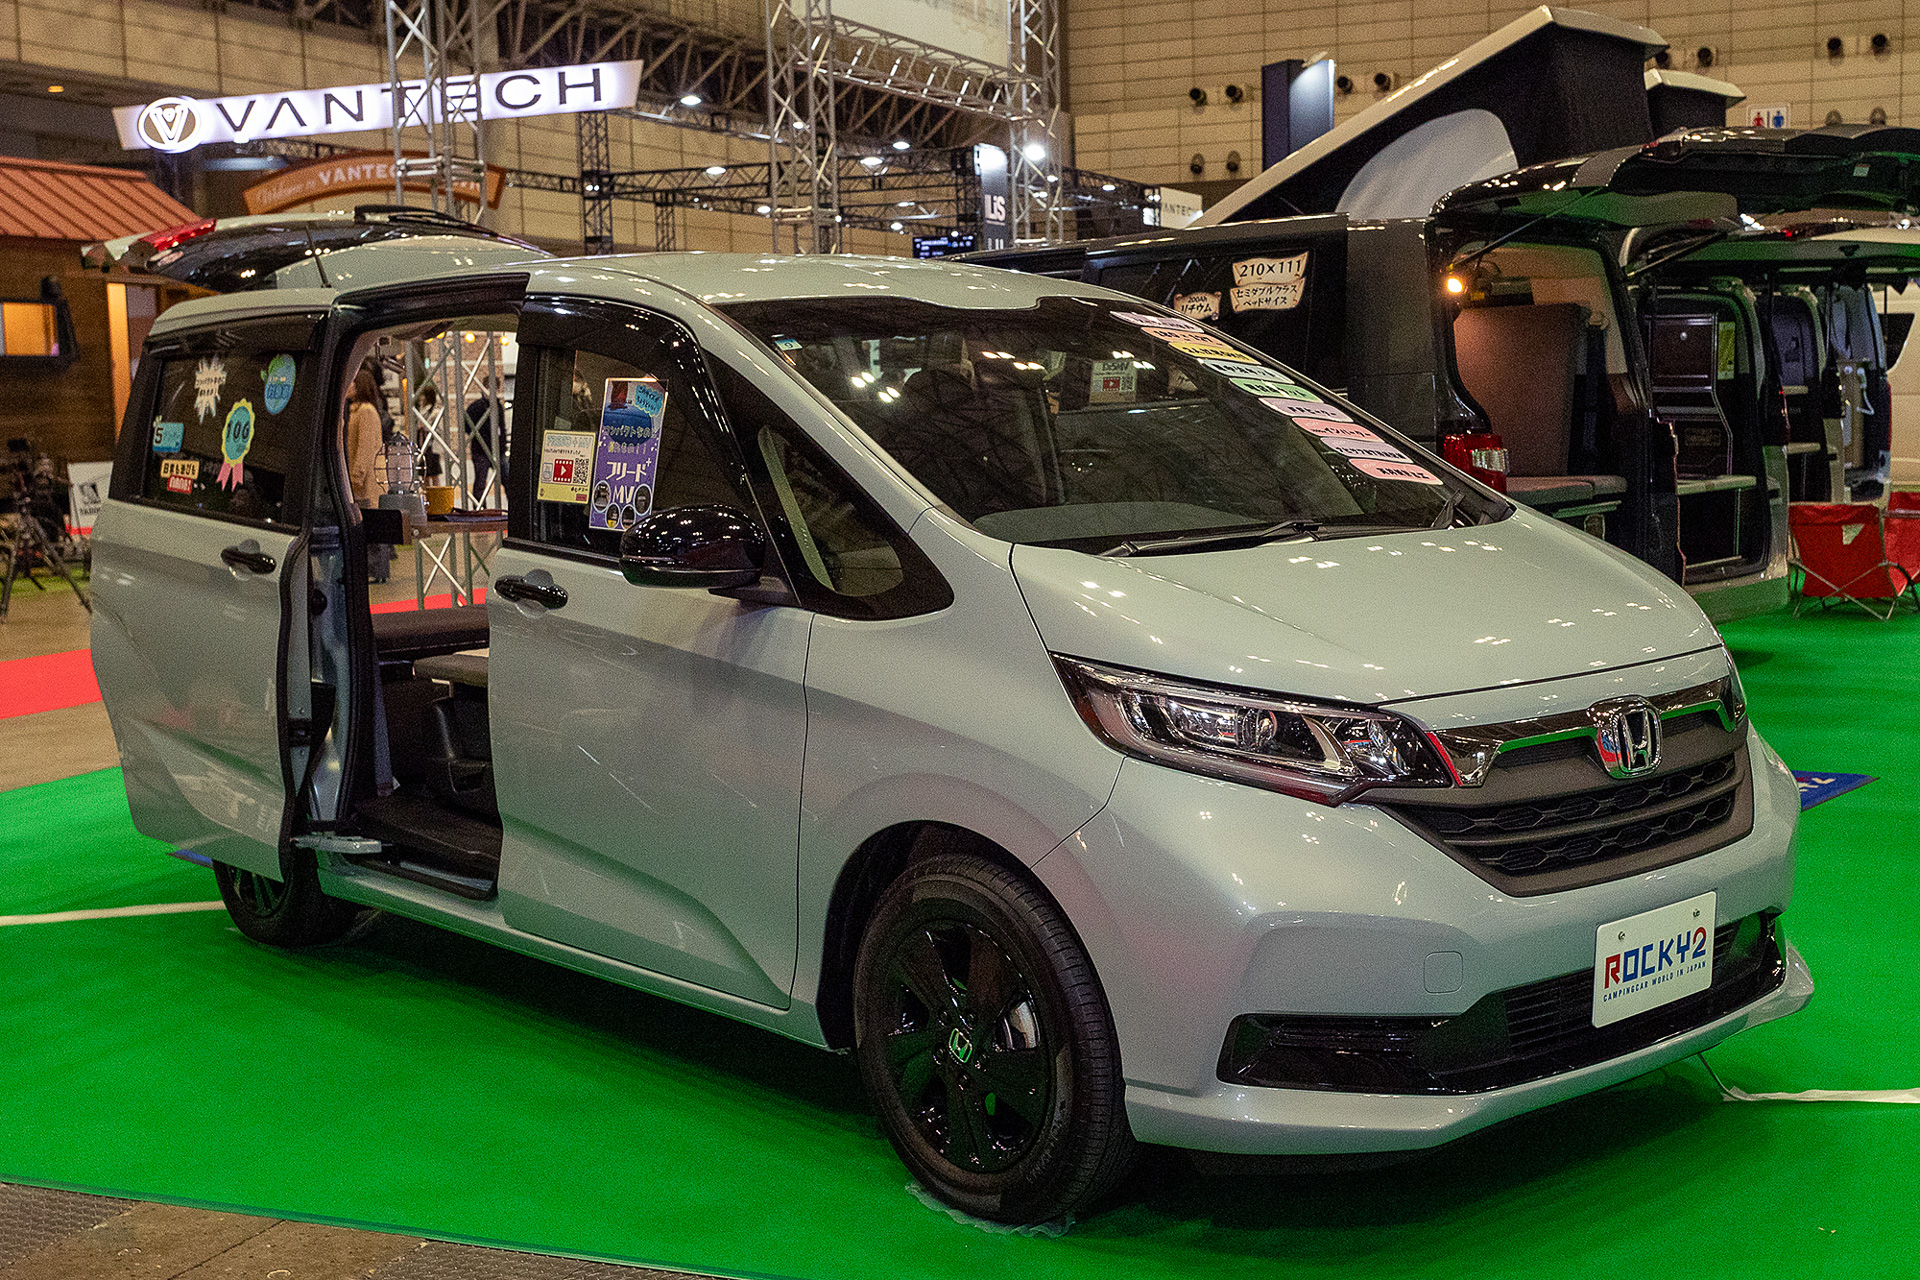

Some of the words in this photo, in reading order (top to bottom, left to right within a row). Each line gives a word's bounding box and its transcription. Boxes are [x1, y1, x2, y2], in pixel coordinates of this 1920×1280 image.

[215, 67, 602, 132] VANTECH
[1180, 302, 1213, 314] リチウム
[612, 485, 635, 504] MV
[1604, 926, 1707, 990] ROCKY2
[1603, 980, 1649, 1002] CAMPINGCAR
[1651, 972, 1674, 986] WORLD
[1676, 968, 1684, 978] IN
[1686, 960, 1706, 974] JAPAN
